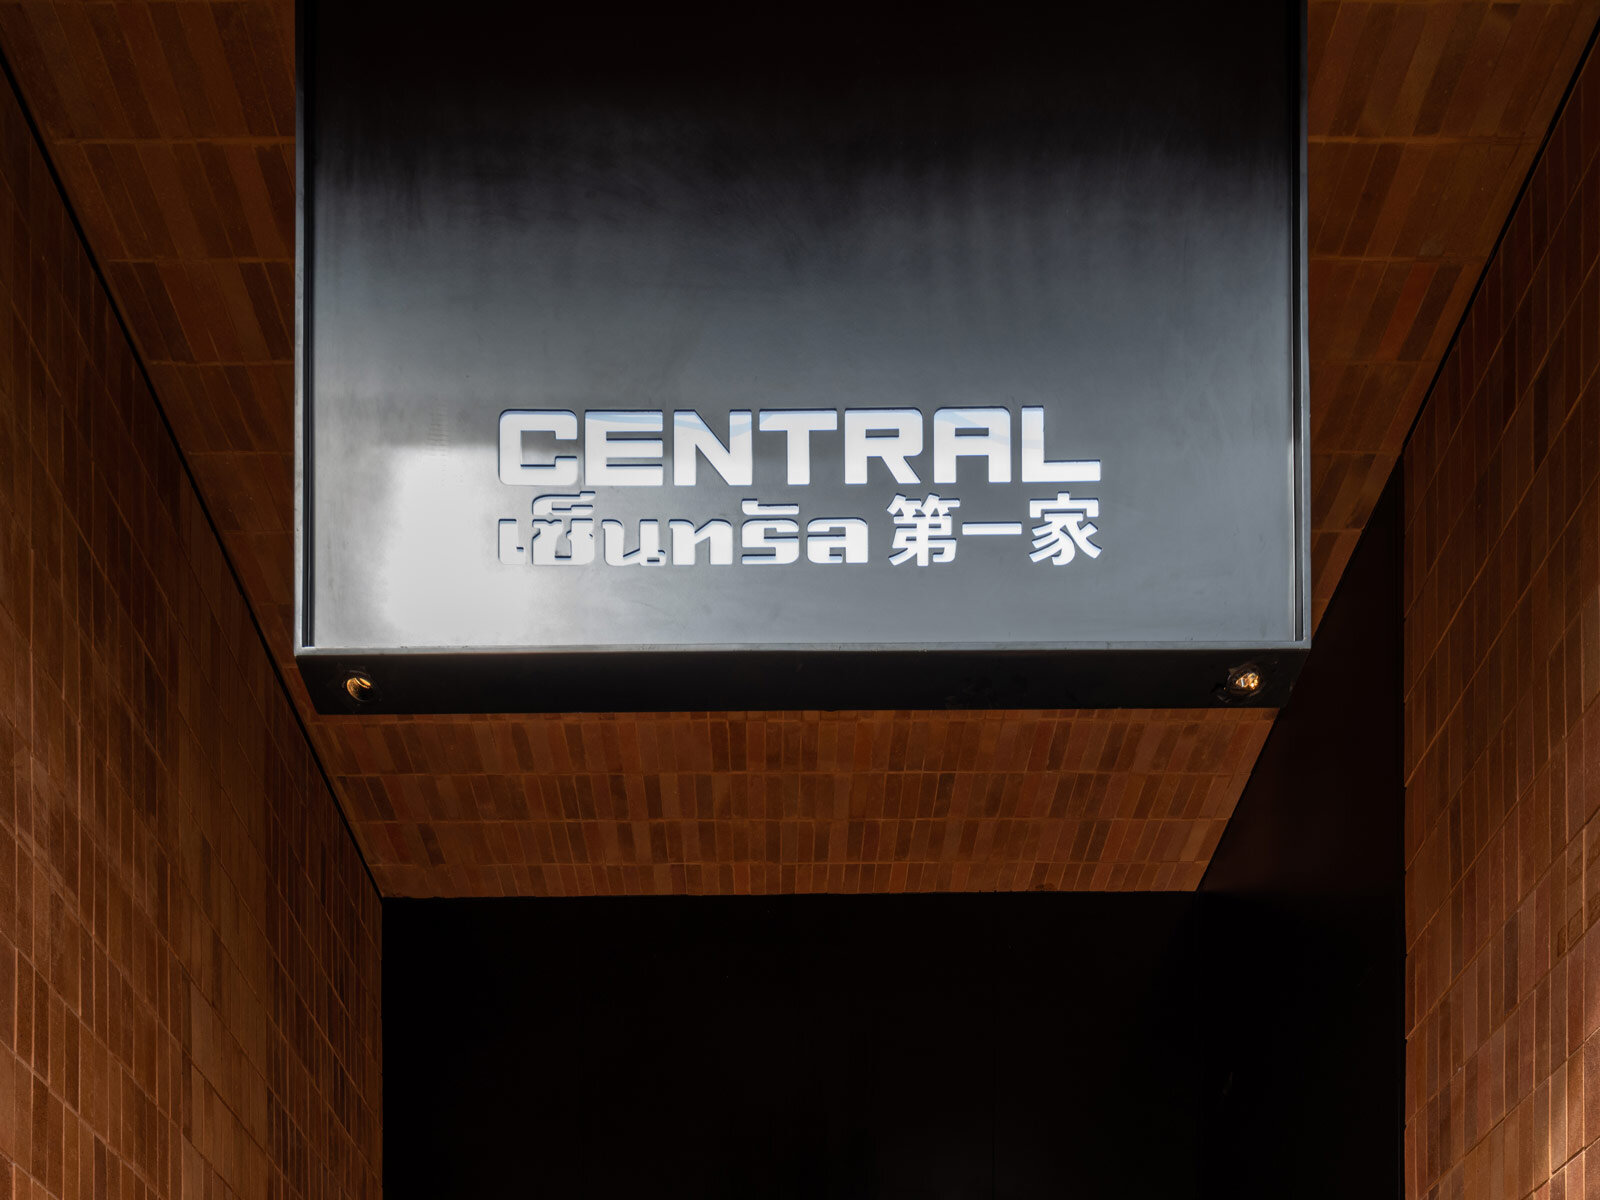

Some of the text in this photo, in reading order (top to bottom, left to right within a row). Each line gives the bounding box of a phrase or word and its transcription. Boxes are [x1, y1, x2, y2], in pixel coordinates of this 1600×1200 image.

[498, 405, 1101, 486] CENTRAL
[498, 491, 1102, 567] เซ็นทรัล 第一家
